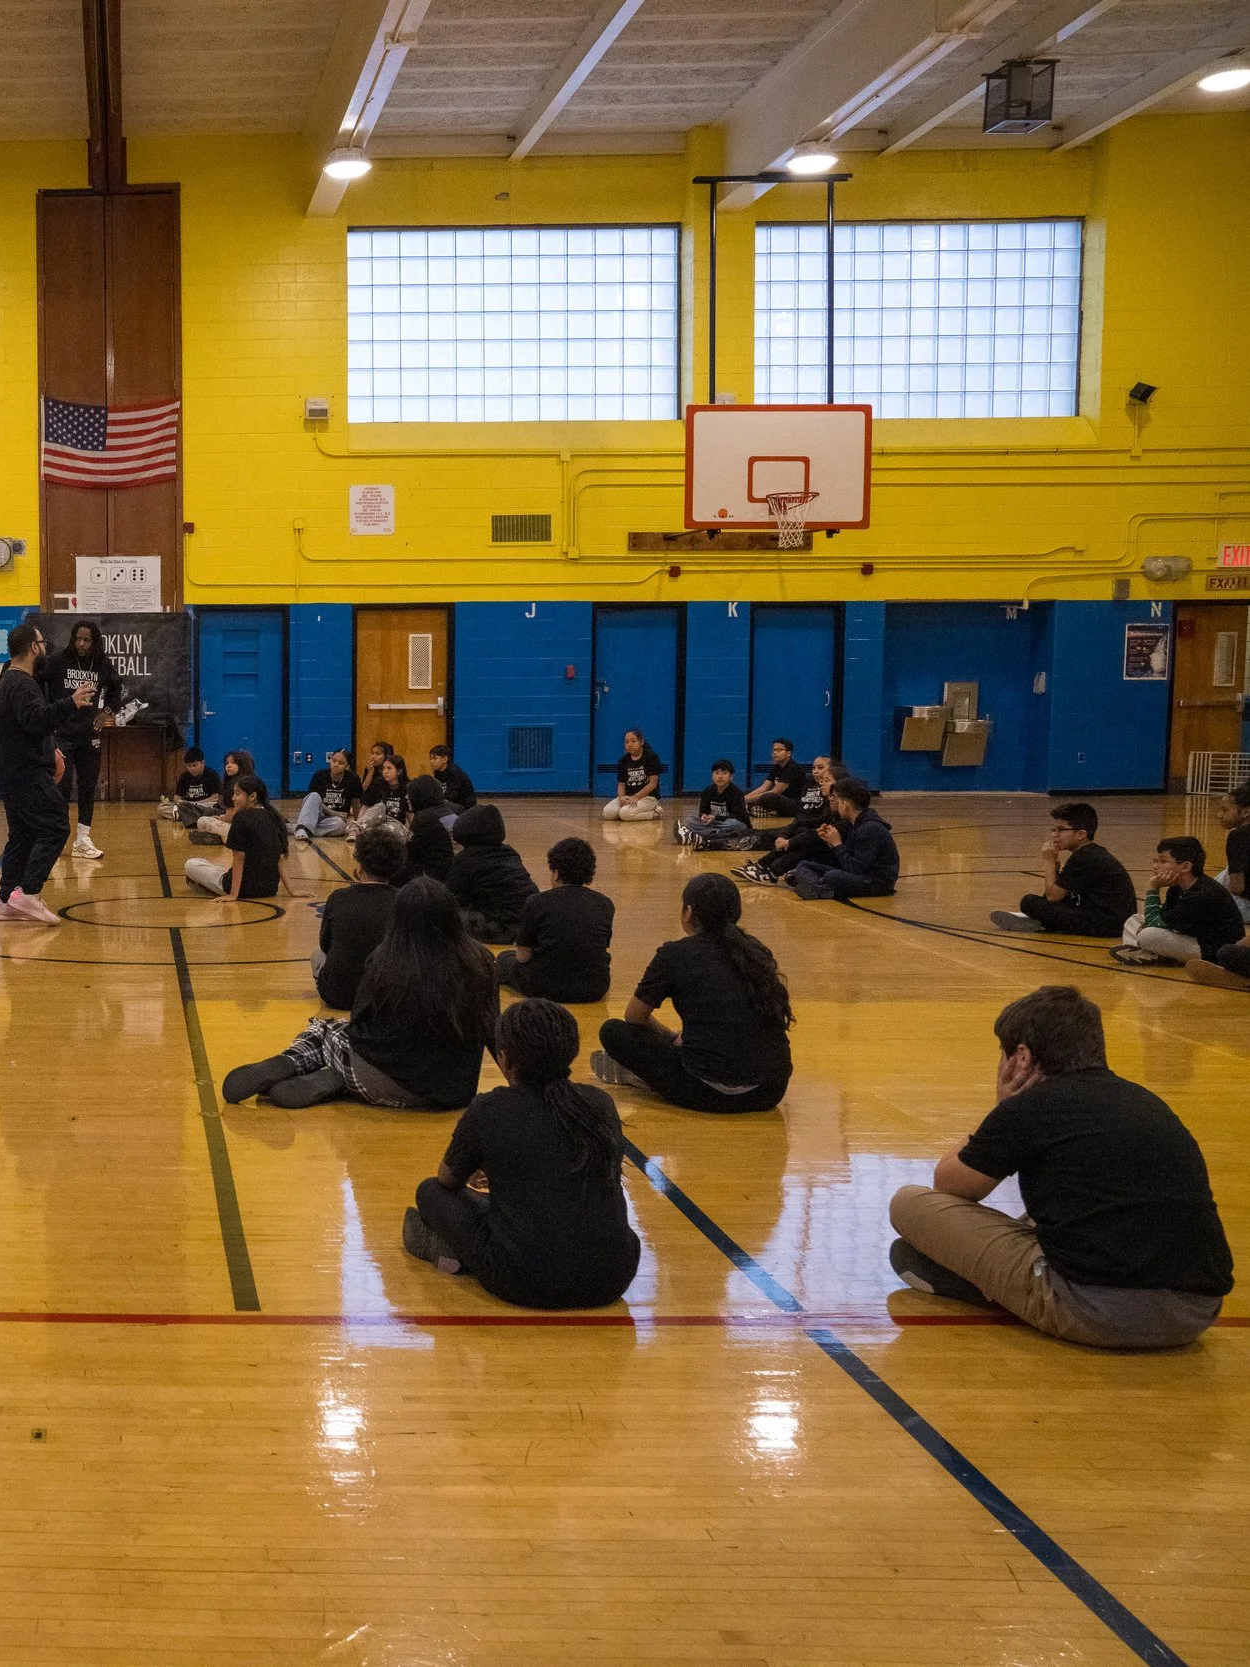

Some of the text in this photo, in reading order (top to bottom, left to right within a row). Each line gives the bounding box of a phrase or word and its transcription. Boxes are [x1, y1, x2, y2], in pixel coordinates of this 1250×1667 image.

[524, 602, 536, 618] J
[728, 602, 739, 618] K
[1151, 601, 1162, 618] N
[102, 634, 142, 654] OKLYN
[109, 656, 152, 676] TBALL
[67, 668, 99, 682] BROOKLYN
